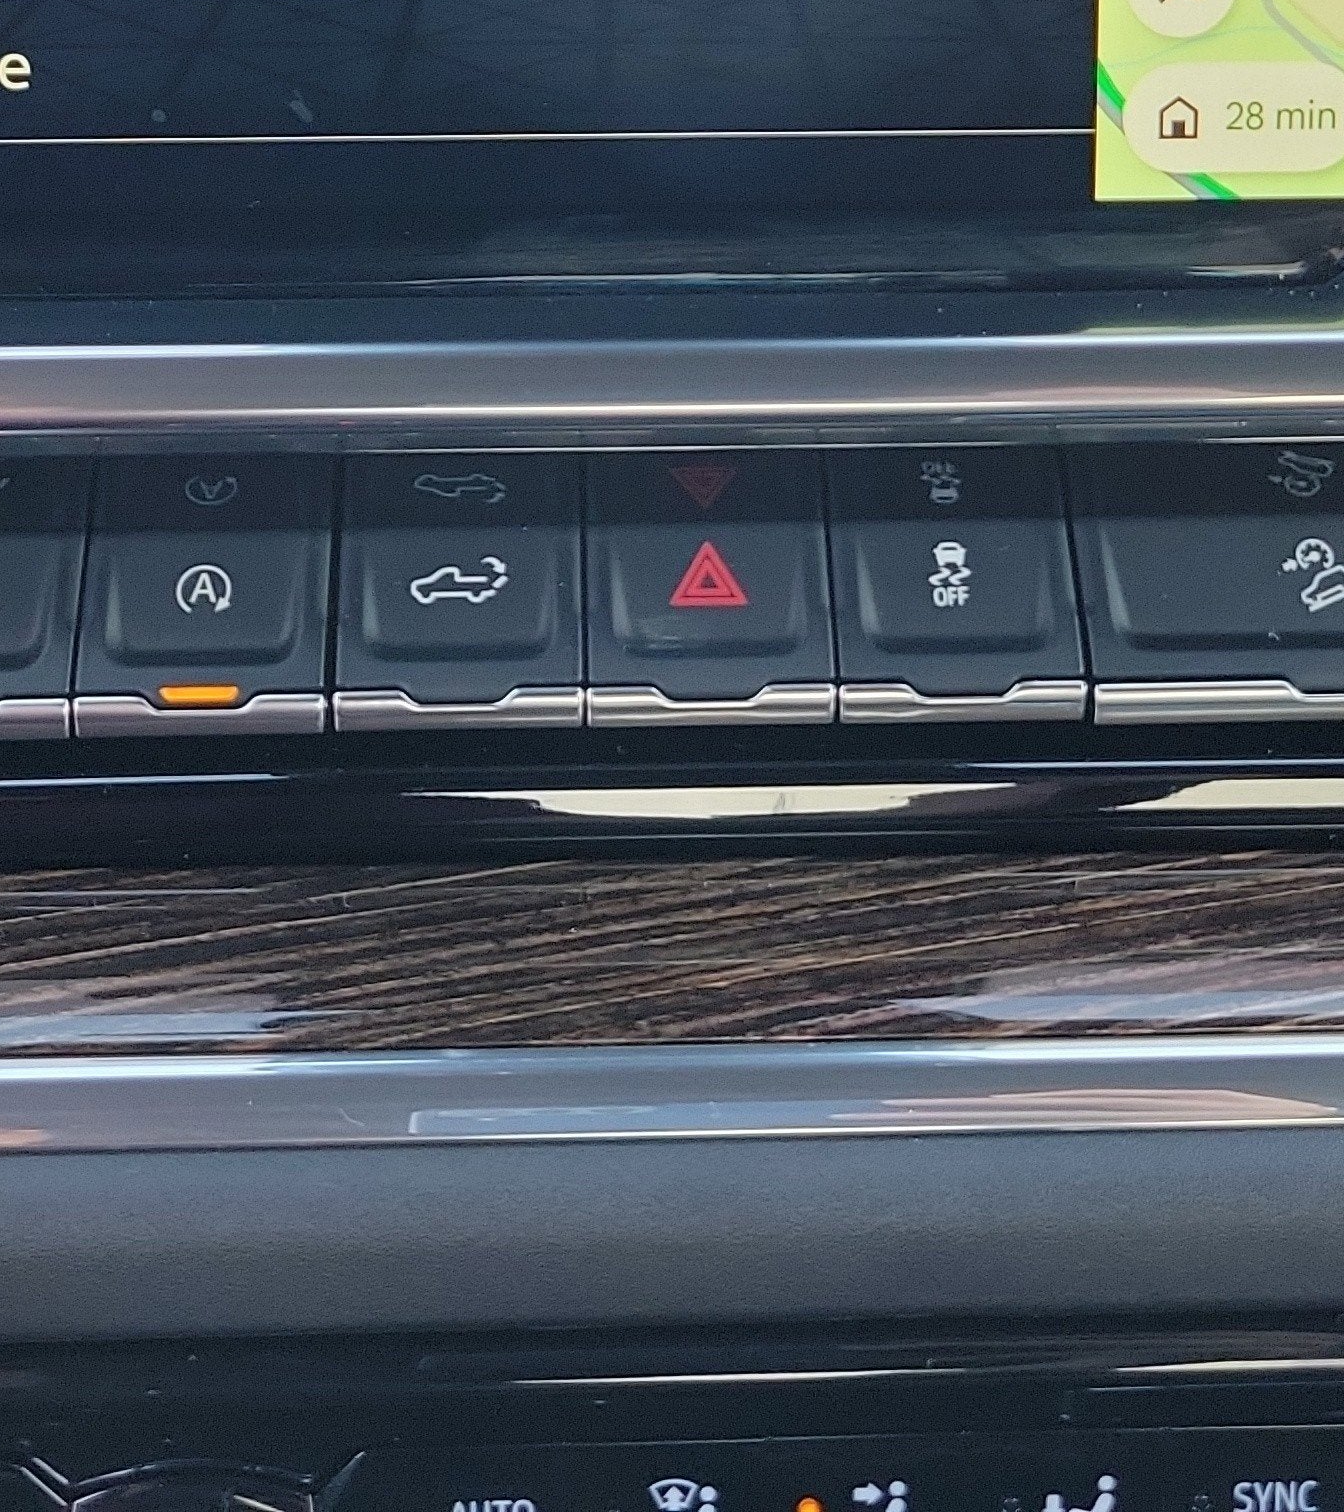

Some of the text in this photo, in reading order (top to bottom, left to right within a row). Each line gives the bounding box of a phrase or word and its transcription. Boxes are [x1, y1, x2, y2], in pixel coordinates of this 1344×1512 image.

[1226, 99, 1337, 131] 28 min
[932, 585, 970, 607] OFF
[1233, 1480, 1318, 1512] SYNC
